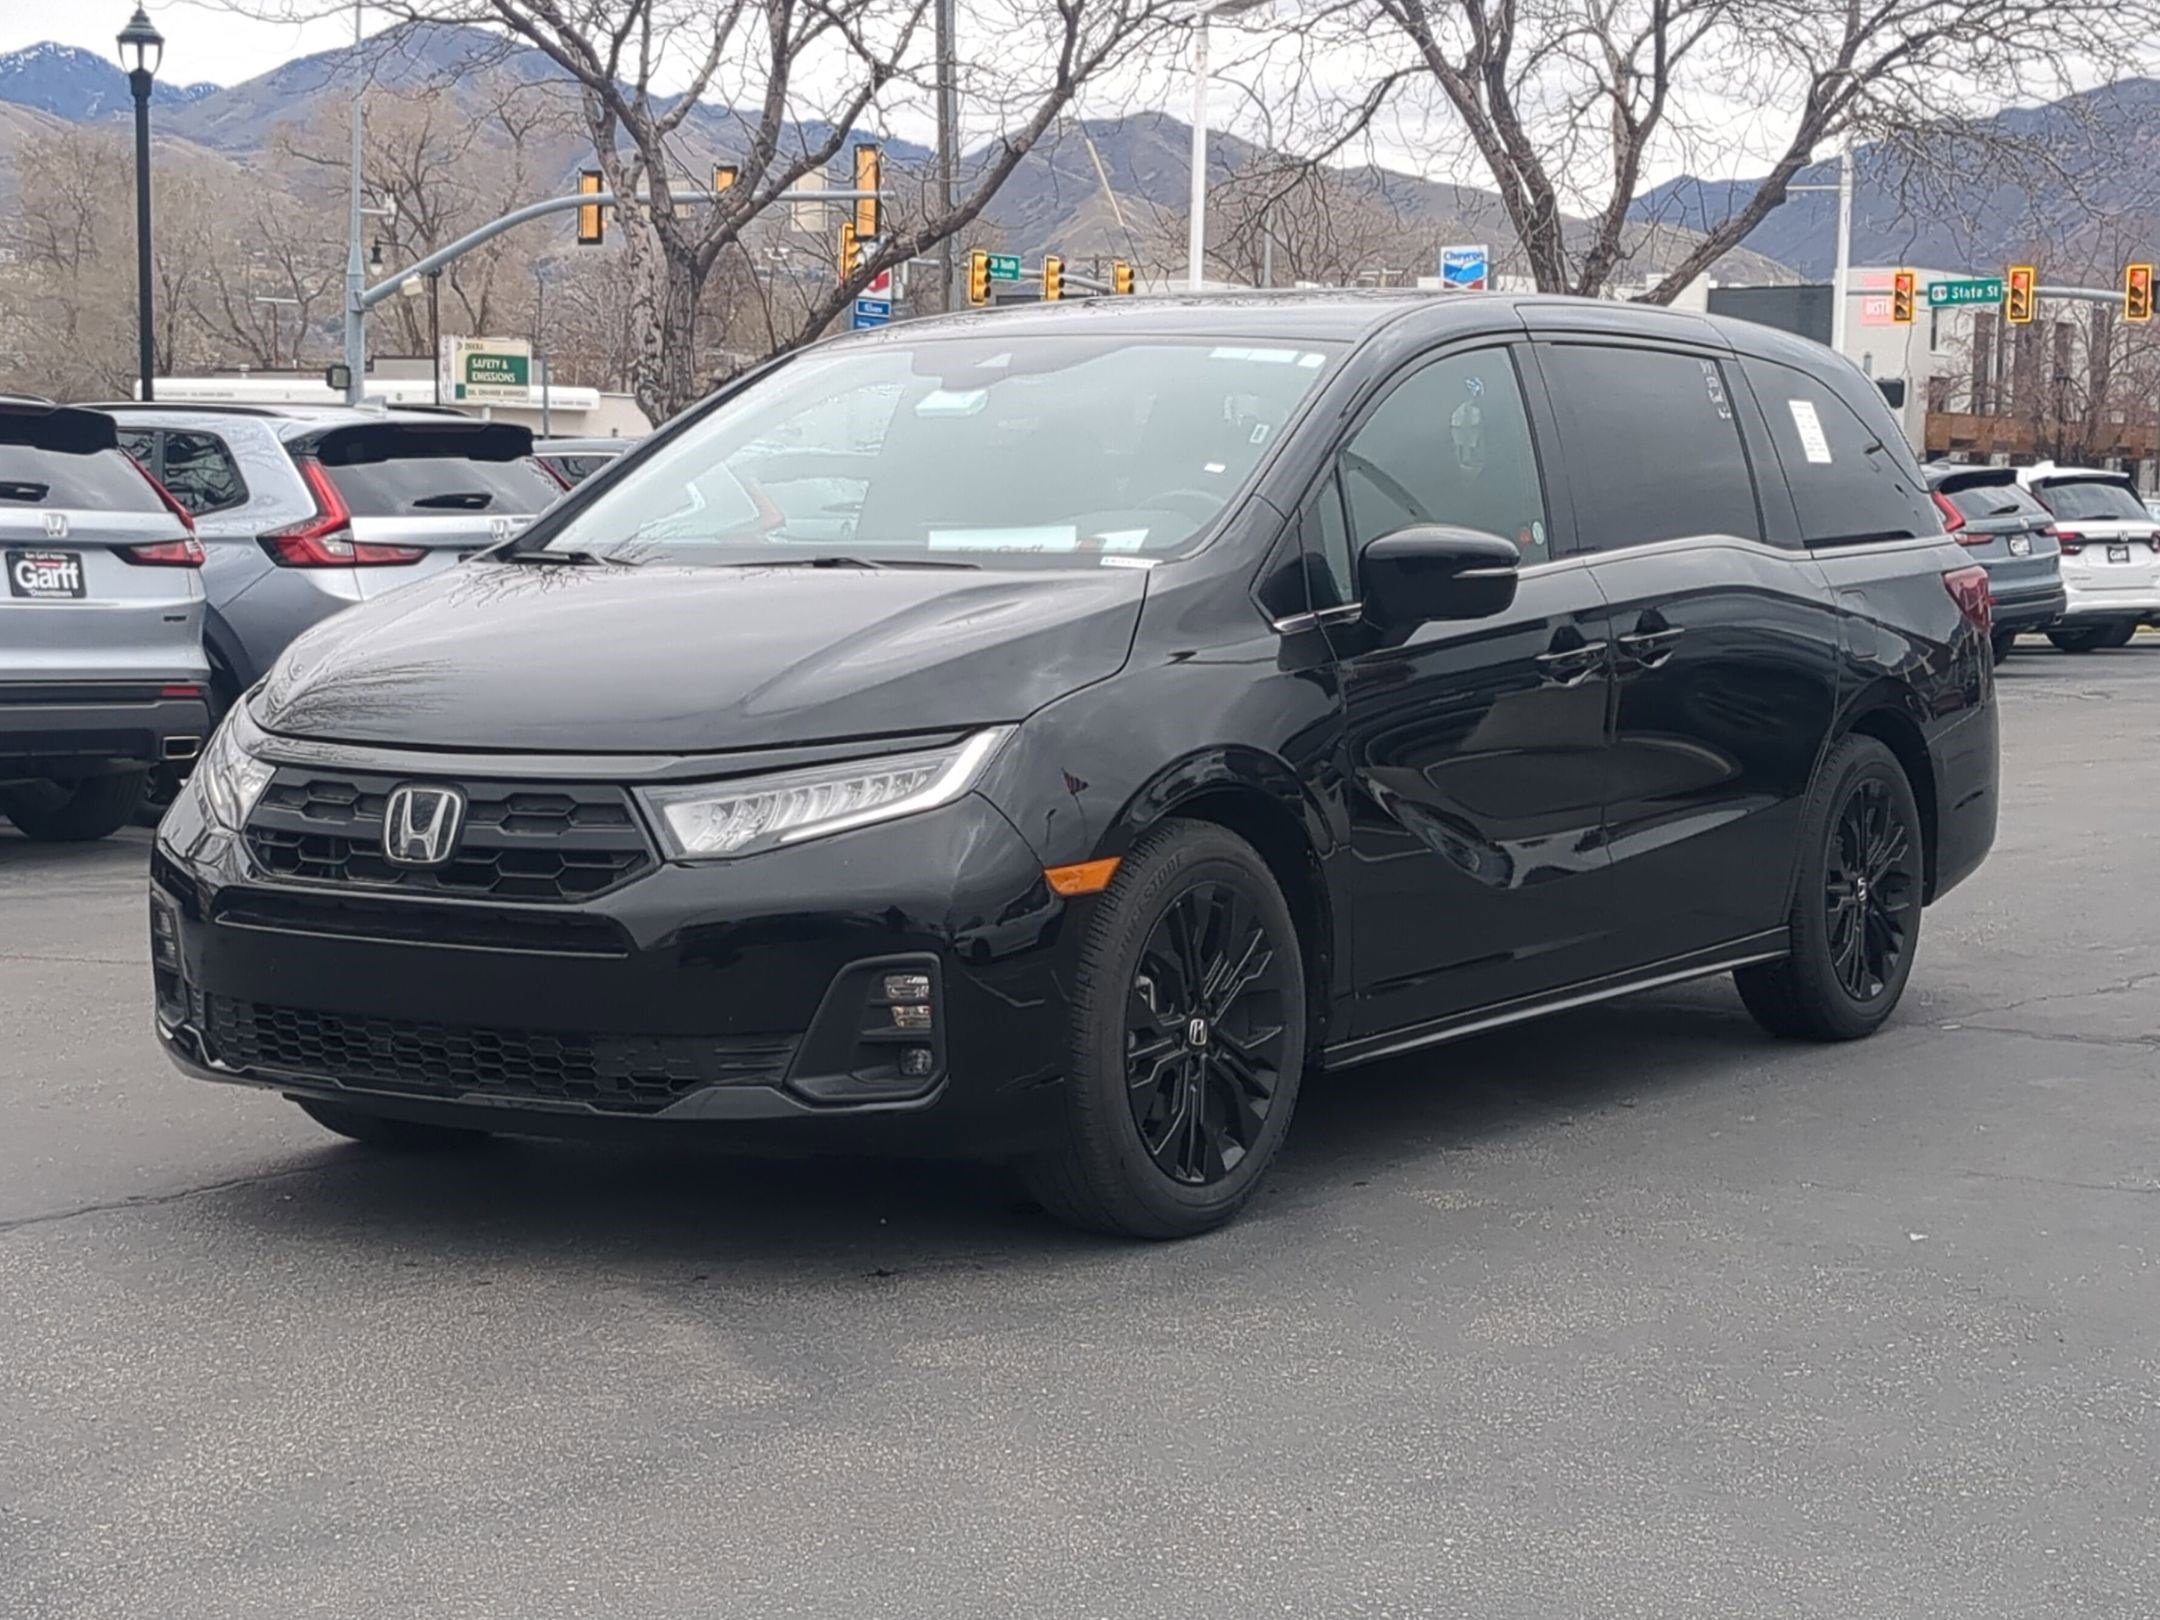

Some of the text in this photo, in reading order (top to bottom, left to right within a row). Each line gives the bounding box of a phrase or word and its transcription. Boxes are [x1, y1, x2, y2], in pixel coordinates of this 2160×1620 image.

[1951, 287, 1983, 299] State
[1987, 285, 1998, 297] St
[472, 358, 500, 369] SAFETY
[472, 371, 516, 383] EMISSIONS
[15, 560, 79, 589] Garff
